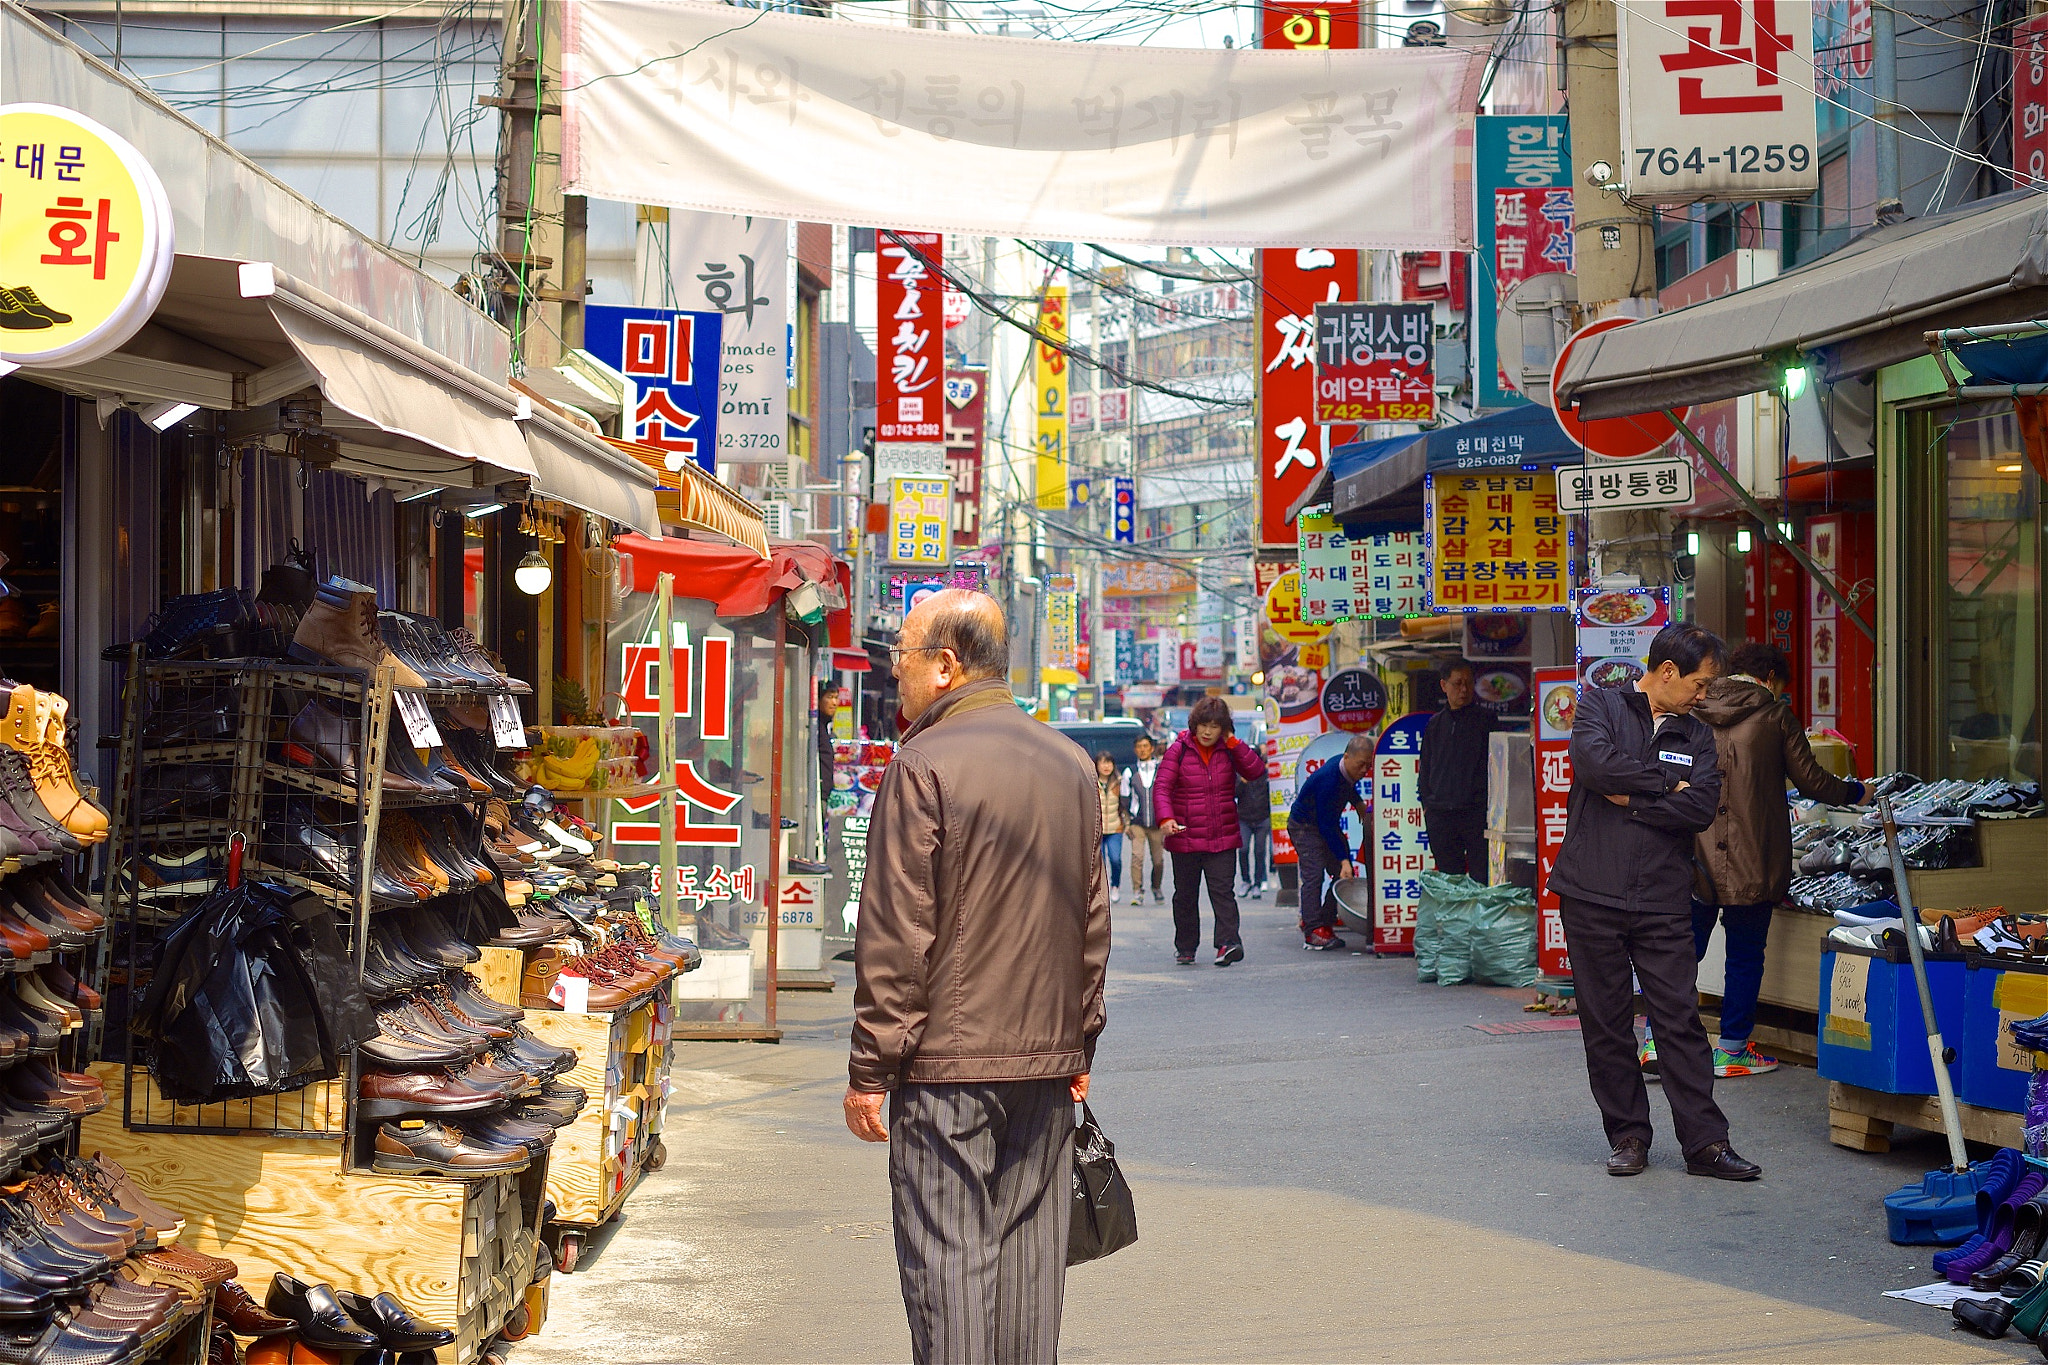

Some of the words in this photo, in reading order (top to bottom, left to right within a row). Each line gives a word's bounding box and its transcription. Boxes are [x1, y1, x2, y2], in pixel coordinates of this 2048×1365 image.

[1659, 0, 1793, 115] 관
[635, 41, 810, 126] 역사와
[858, 69, 1025, 143] 전통의
[1072, 86, 1240, 159] 먹거리
[1284, 88, 1403, 160] 골목
[0, 142, 85, 182] 대문
[1635, 143, 1810, 176] 764-1259
[722, 342, 776, 357] made
[1322, 312, 1430, 367] 귀청소방
[622, 314, 701, 457] 미소
[1321, 377, 1431, 402] 예약필수
[1321, 403, 1431, 419] 742-1522
[1456, 435, 1525, 456] 현대천막
[1457, 454, 1523, 469] 925-0837
[903, 482, 943, 494] 동대문
[1458, 476, 1534, 491] 호남집
[1571, 468, 1679, 502] 일방통행
[895, 497, 948, 521] 슈퍼
[1441, 493, 1557, 513] 순대국
[899, 523, 940, 539] 담배
[1442, 516, 1561, 535] 감자탕
[898, 542, 940, 559] 잡화
[1441, 539, 1561, 558] 삼겹살
[1441, 561, 1560, 581] 곱창볶음
[1443, 583, 1559, 603] 머리고기
[1344, 673, 1360, 690] 귀
[1328, 690, 1379, 712] 청소방
[612, 636, 745, 847] 미소
[743, 910, 814, 926] 367-6878
